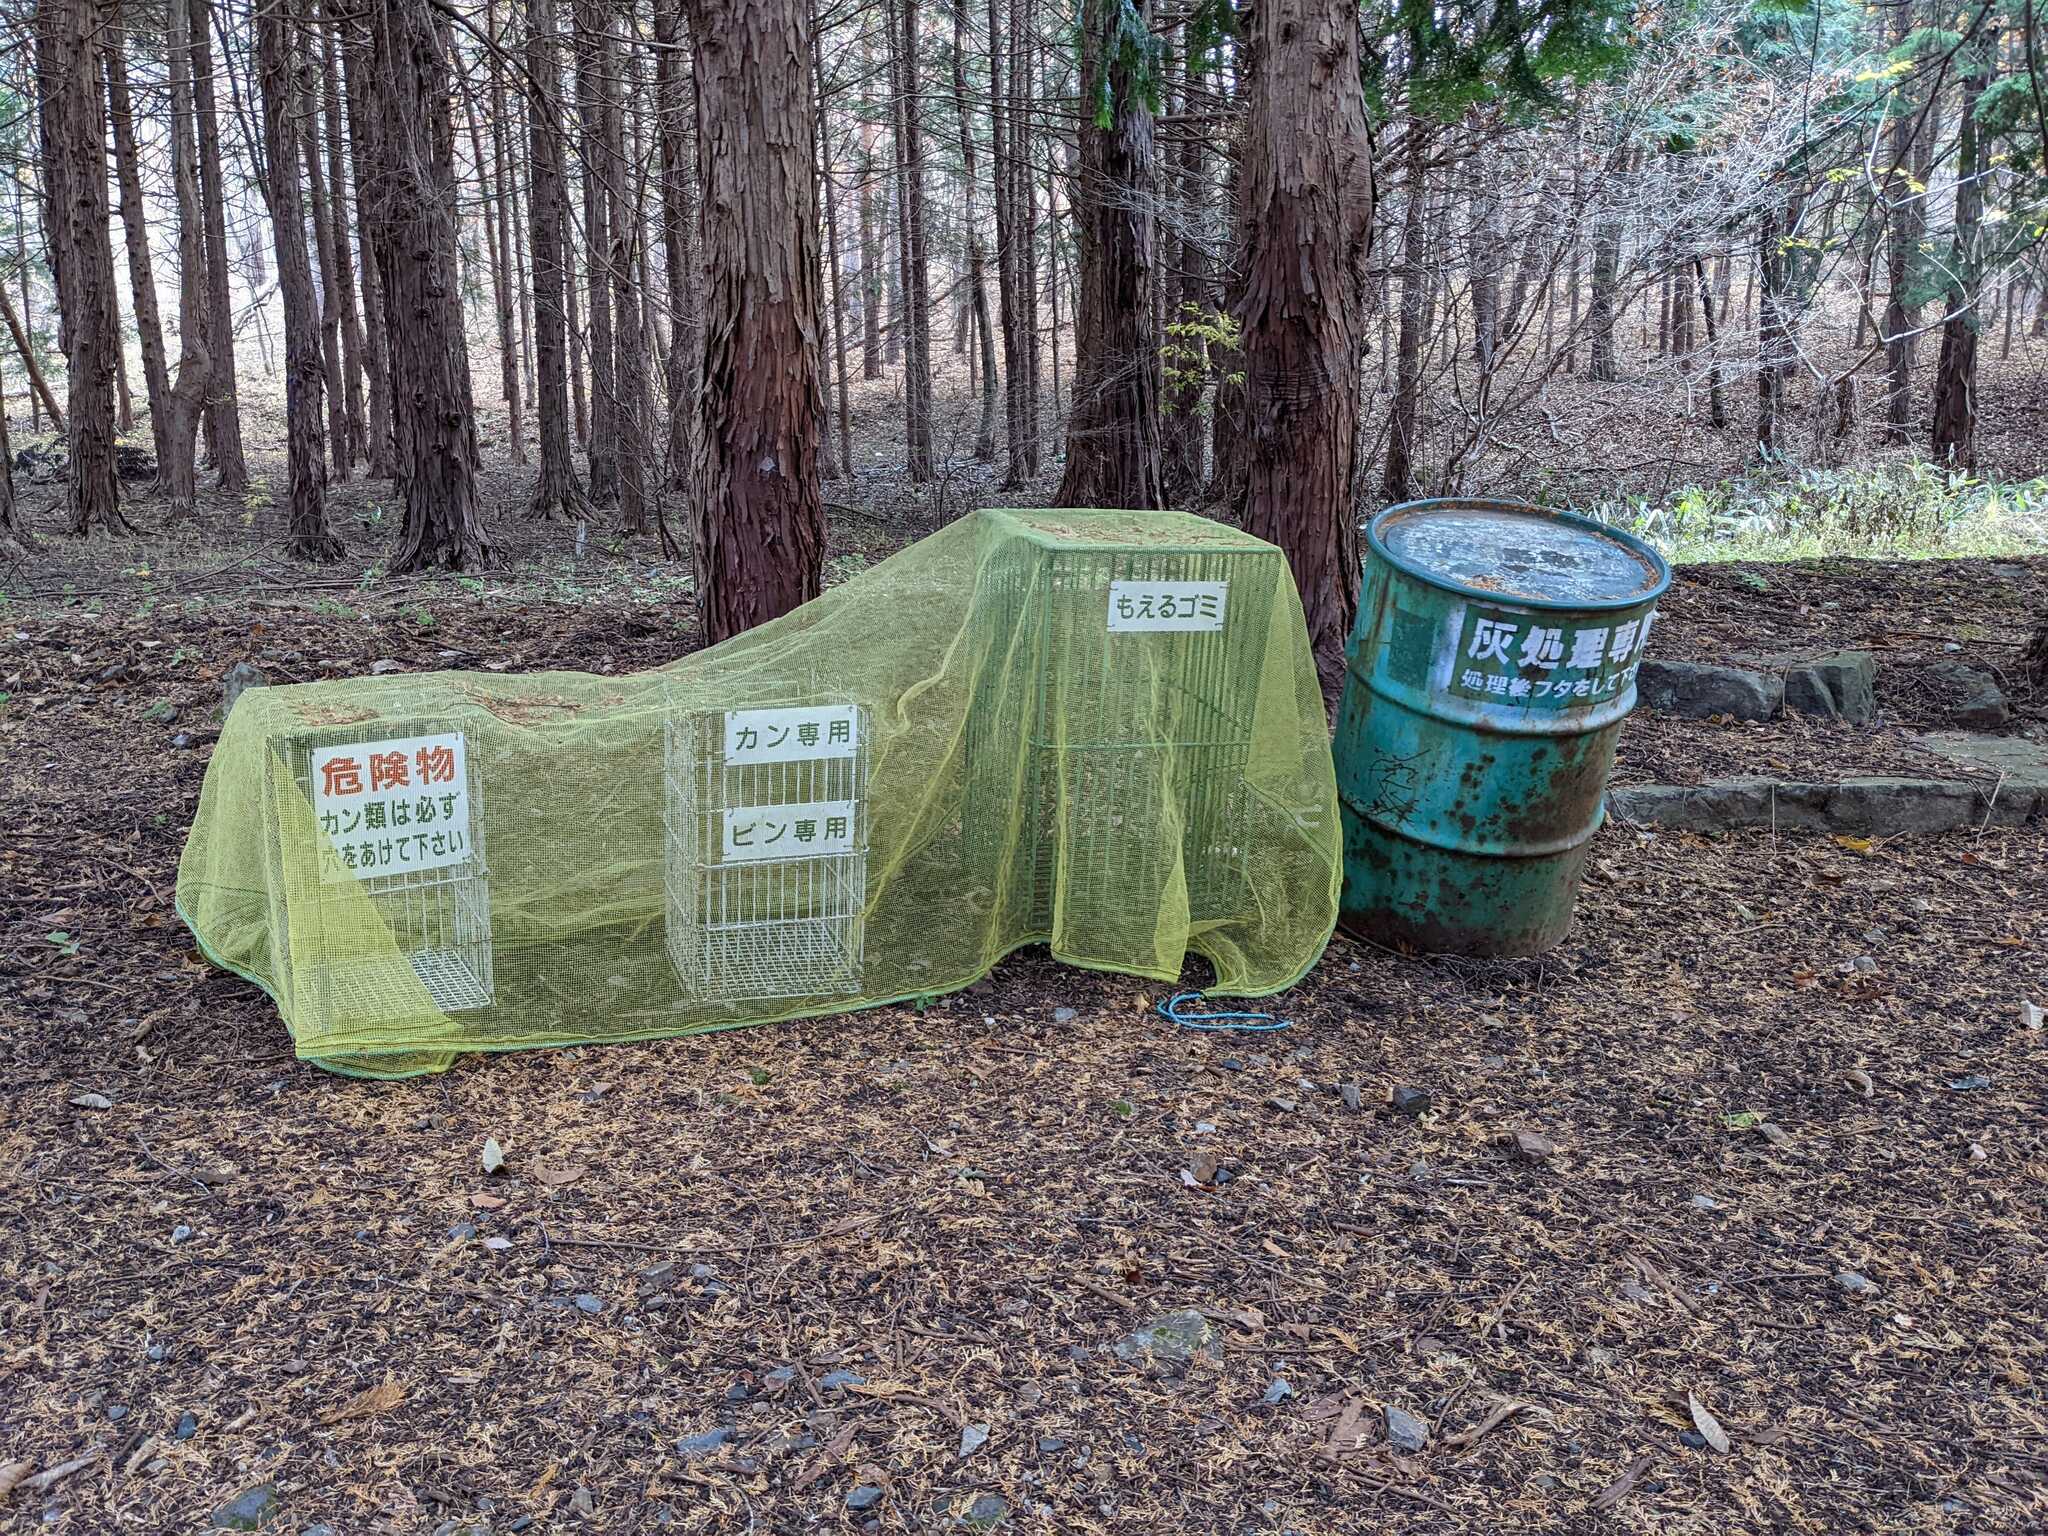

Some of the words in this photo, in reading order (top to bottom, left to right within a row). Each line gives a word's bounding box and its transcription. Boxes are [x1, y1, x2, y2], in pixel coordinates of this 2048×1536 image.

[1117, 594, 1218, 619] もえるゴミ
[736, 720, 850, 750] カン専用
[320, 745, 455, 797] 危険物
[320, 791, 461, 835] カン類は必ず
[733, 816, 847, 846] ビン専用
